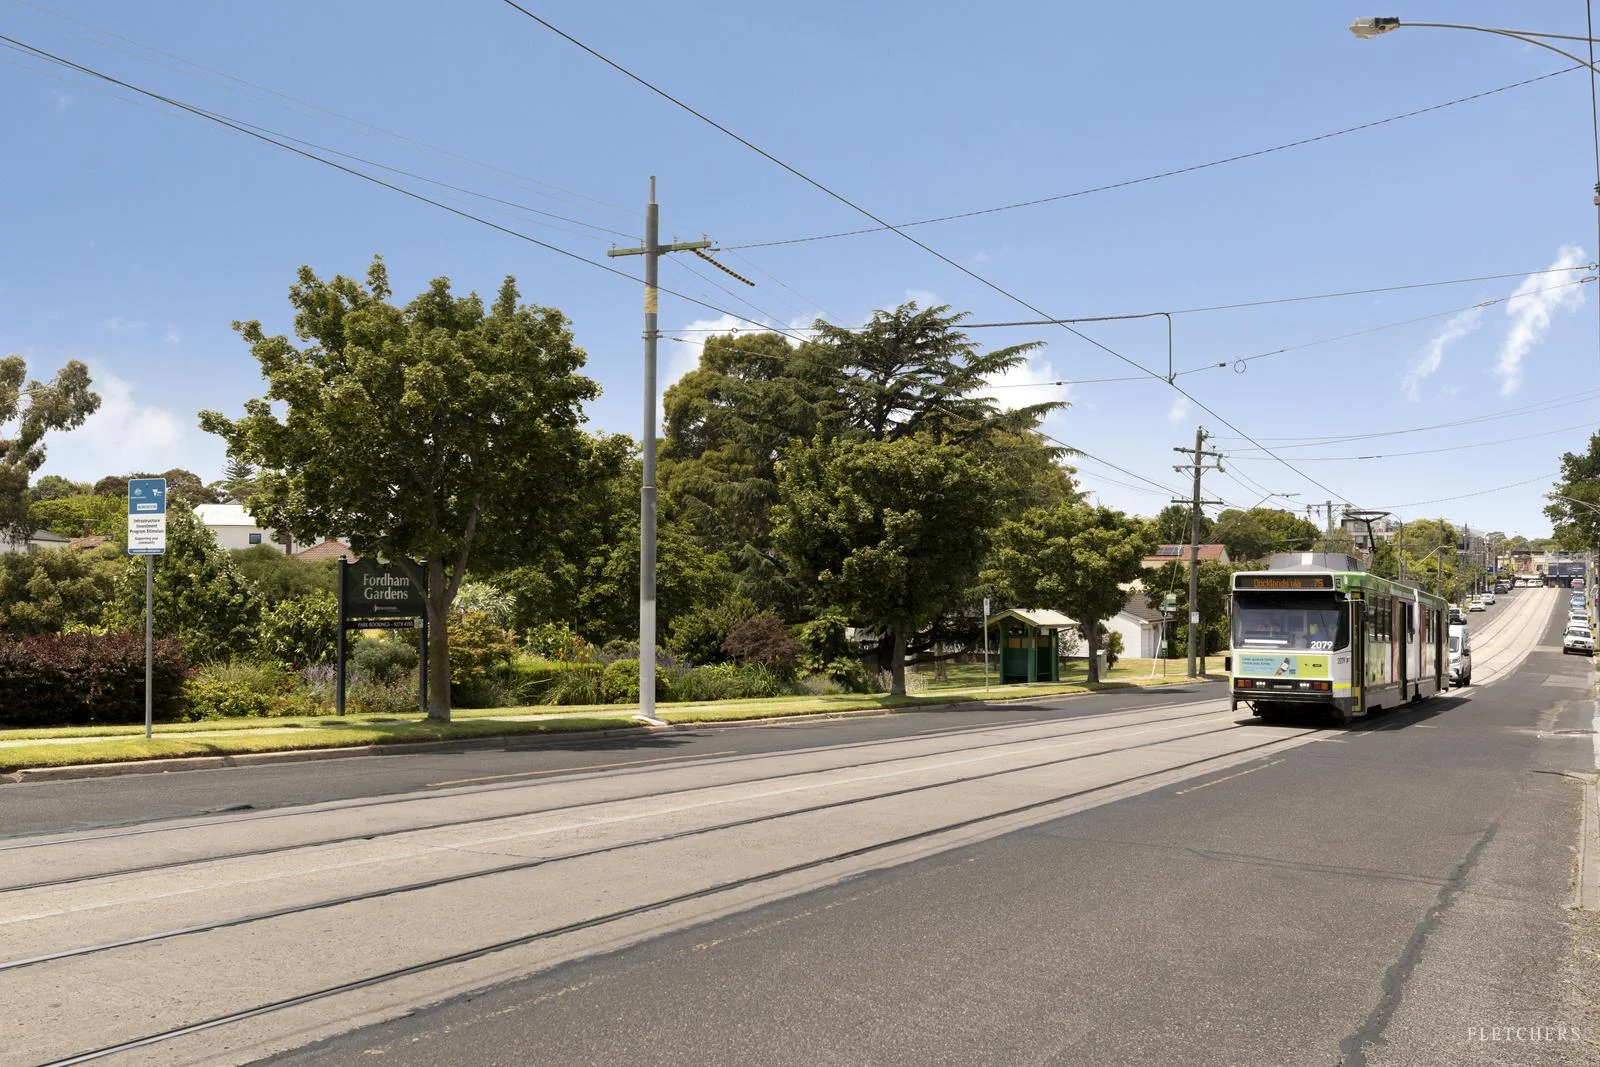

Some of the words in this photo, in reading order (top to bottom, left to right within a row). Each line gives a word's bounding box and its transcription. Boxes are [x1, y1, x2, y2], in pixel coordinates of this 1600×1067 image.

[363, 572, 410, 586] Fordham
[364, 587, 409, 600] Gardens
[1310, 640, 1333, 650] 2079
